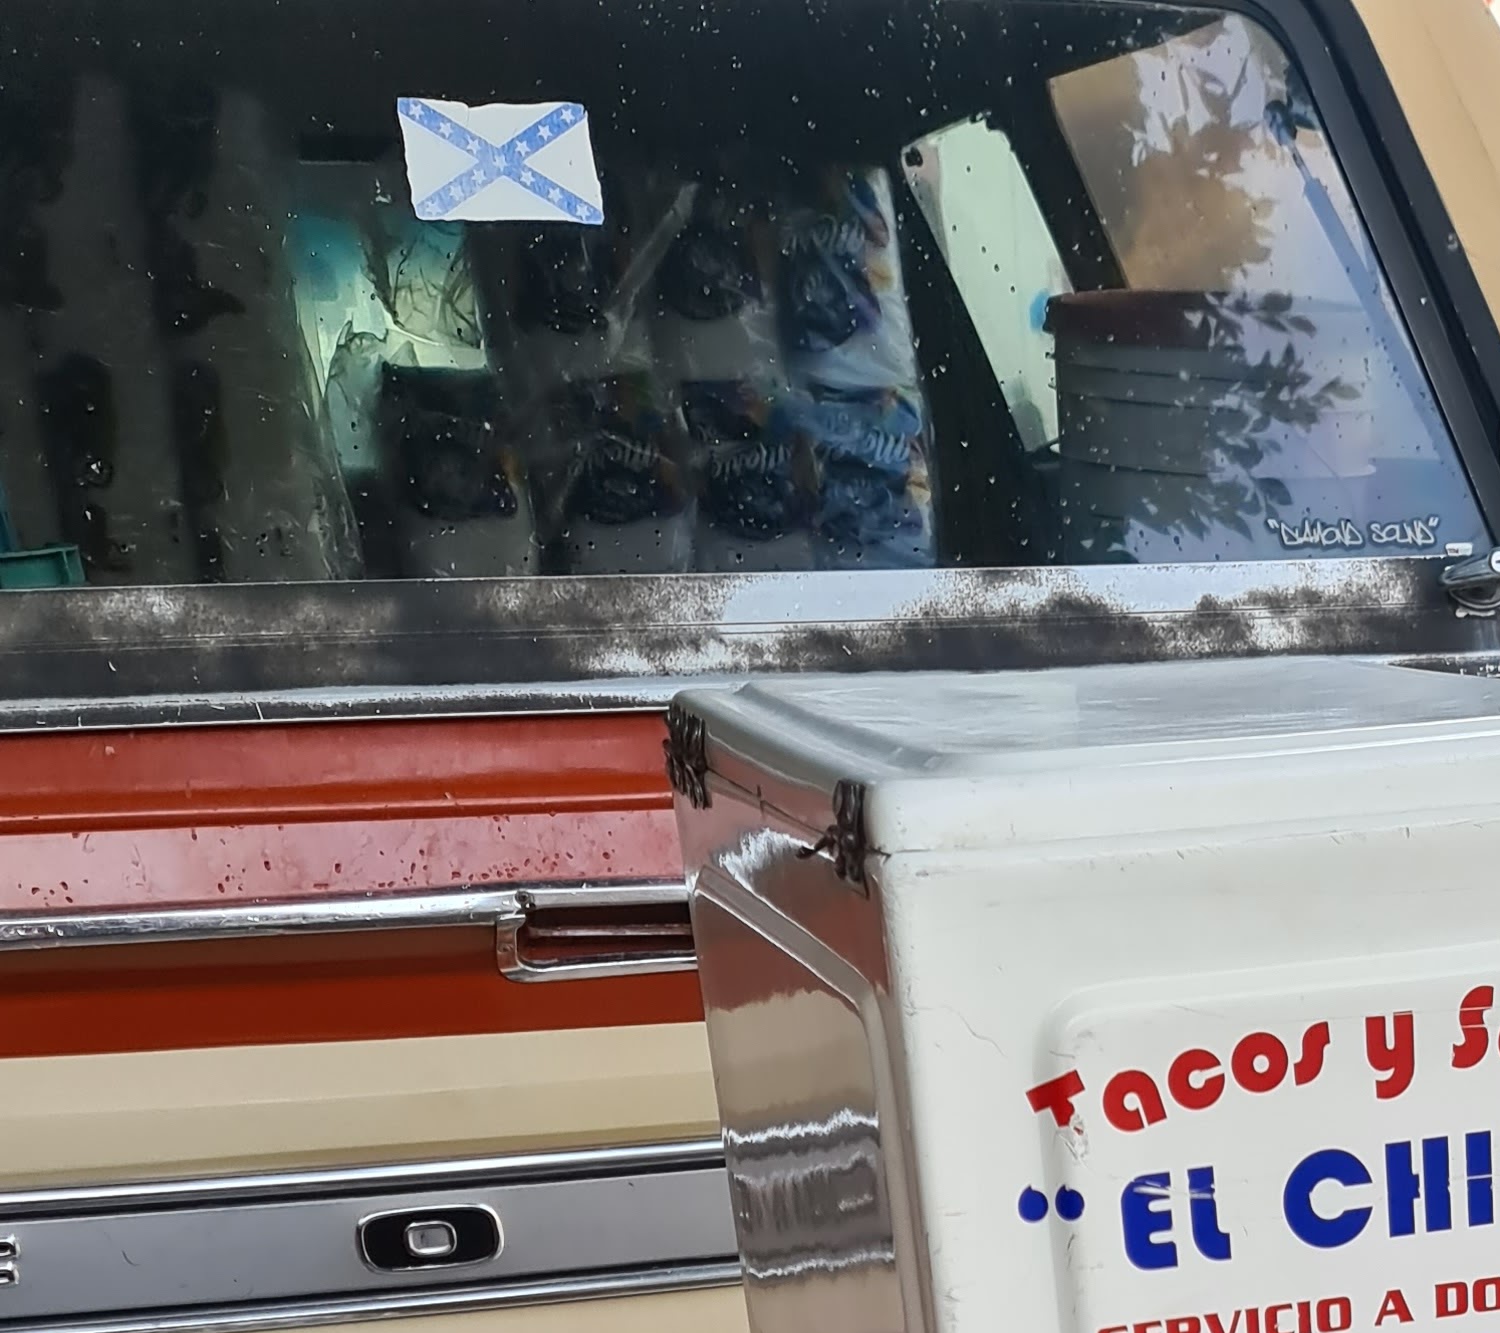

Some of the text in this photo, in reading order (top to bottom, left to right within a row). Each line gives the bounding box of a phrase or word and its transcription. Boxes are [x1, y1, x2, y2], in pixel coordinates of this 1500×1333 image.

[1025, 1022, 1331, 1134] Tacos
[1365, 1010, 1415, 1100] y
[1375, 1290, 1412, 1326] A
